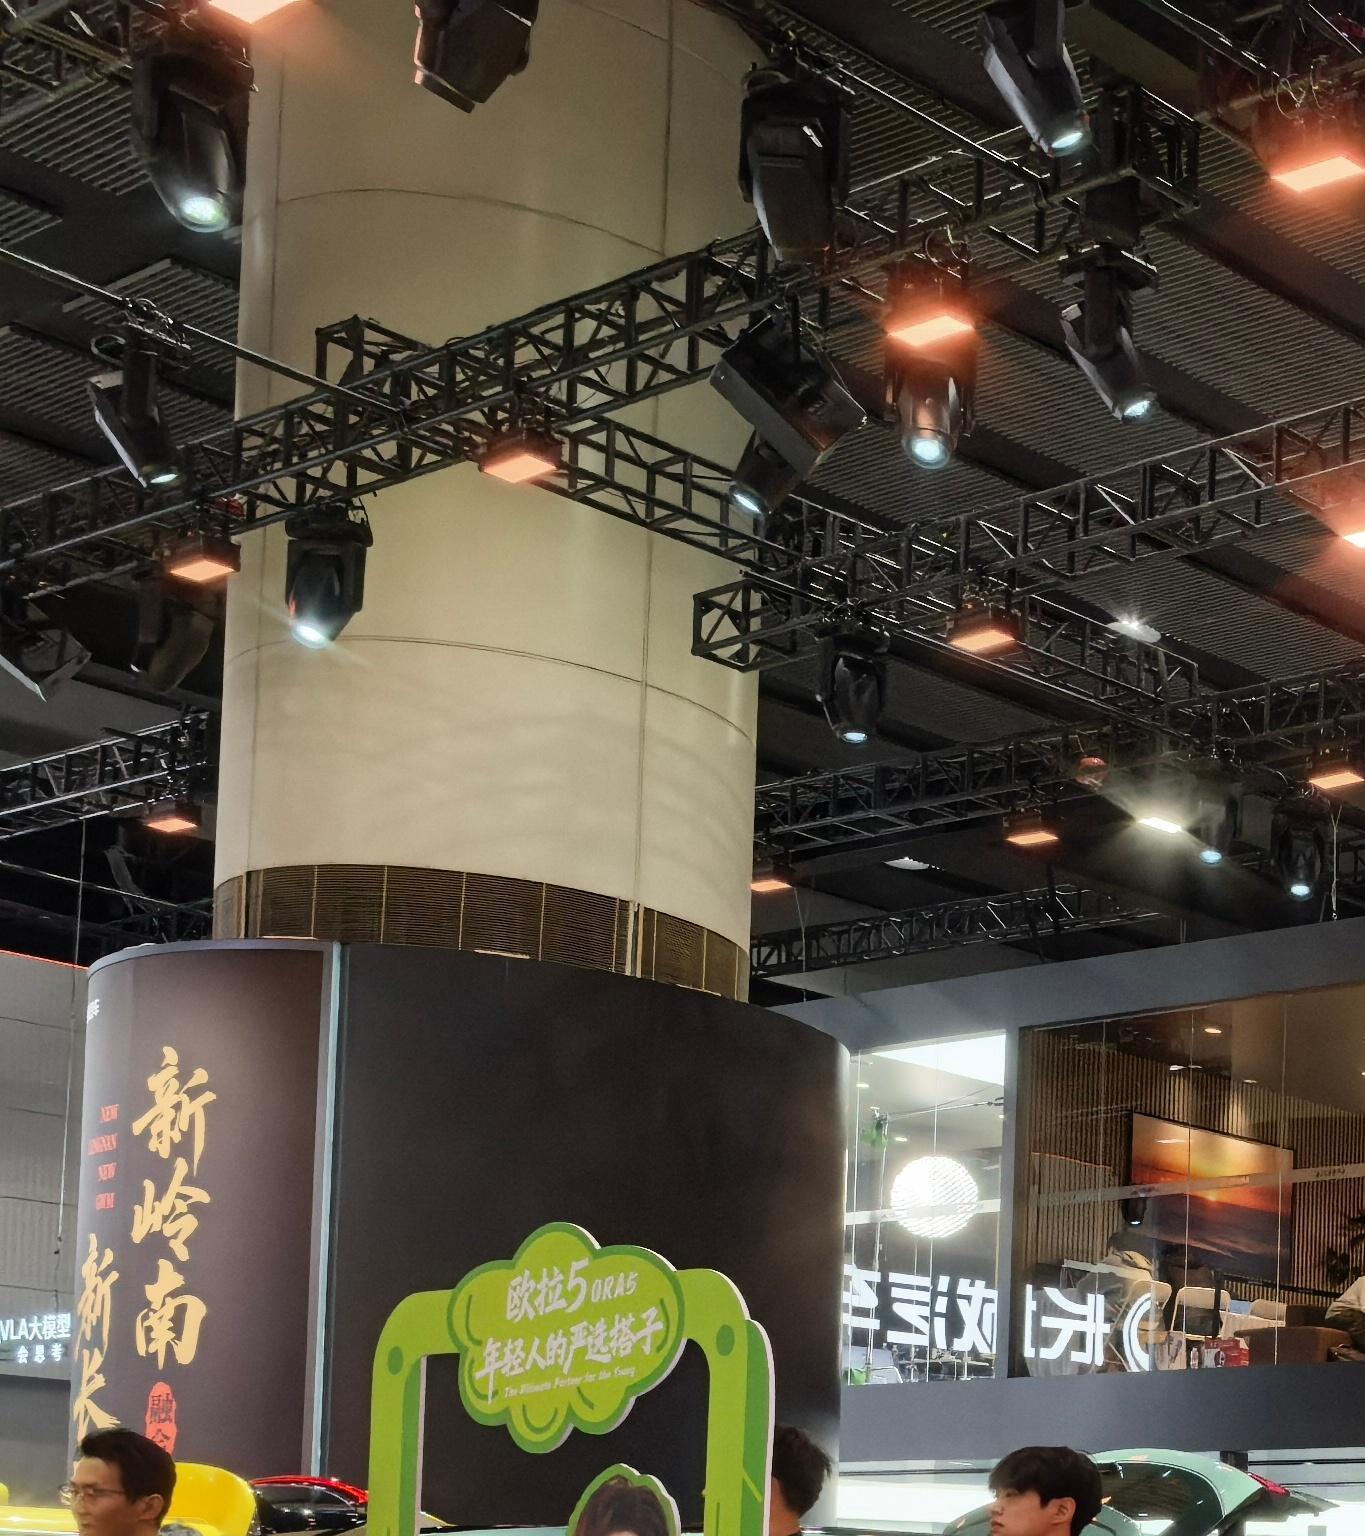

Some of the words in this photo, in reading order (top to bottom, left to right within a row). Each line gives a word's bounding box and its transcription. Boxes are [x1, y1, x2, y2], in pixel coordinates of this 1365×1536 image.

[131, 1046, 217, 1370] 新岭南
[0, 1313, 71, 1341] VLA大模型
[506, 1257, 590, 1323] 欧拉5
[590, 1272, 639, 1303] ORA5
[475, 1306, 664, 1405] 年轻人的严选搭子
